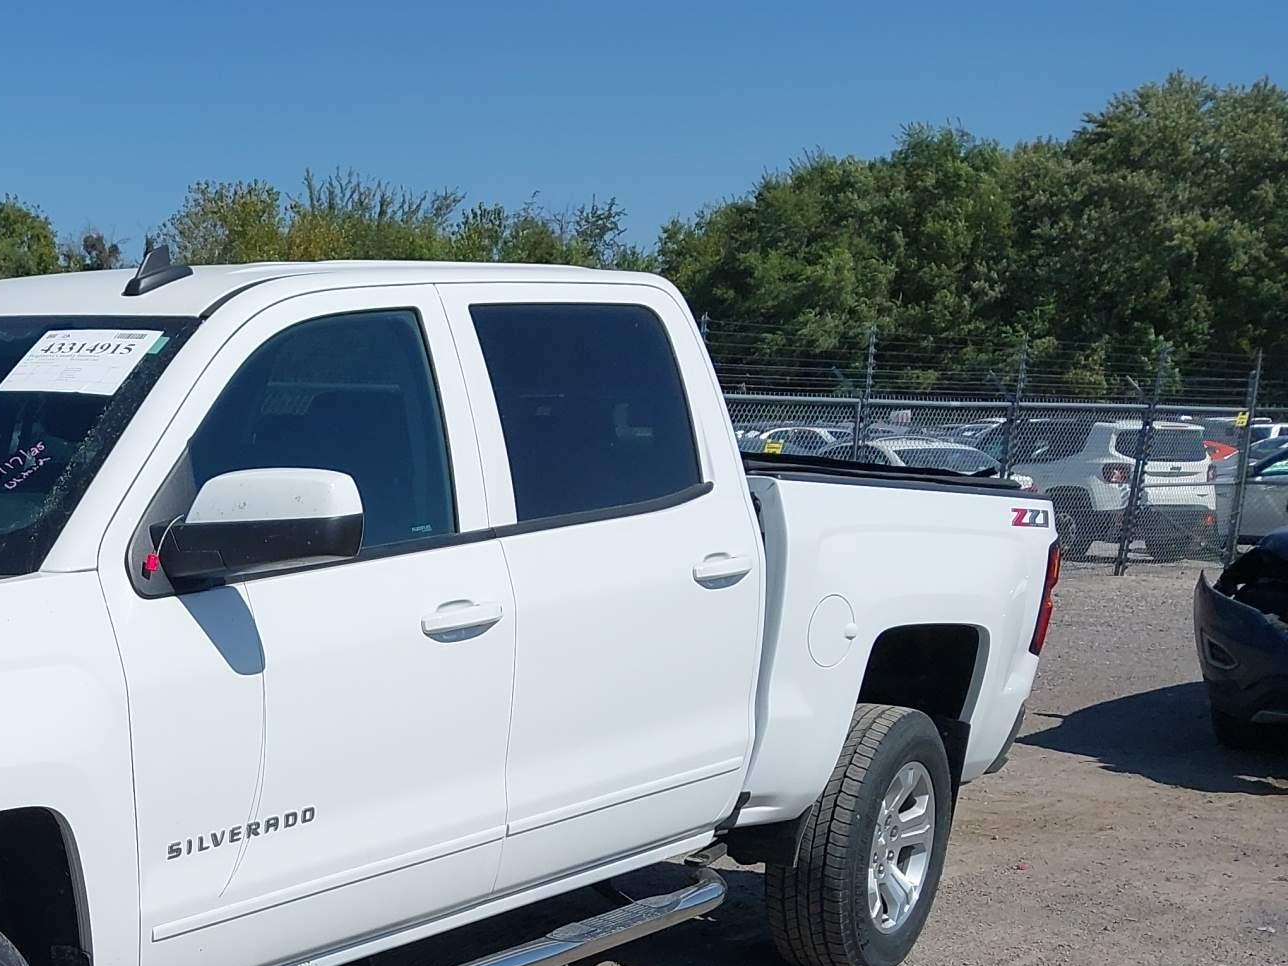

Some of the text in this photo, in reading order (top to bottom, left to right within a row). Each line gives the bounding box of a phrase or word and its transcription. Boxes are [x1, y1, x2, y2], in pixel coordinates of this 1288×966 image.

[40, 342, 136, 355] 43314915
[1011, 508, 1049, 528] Z71
[167, 806, 315, 860] SILVERADO
